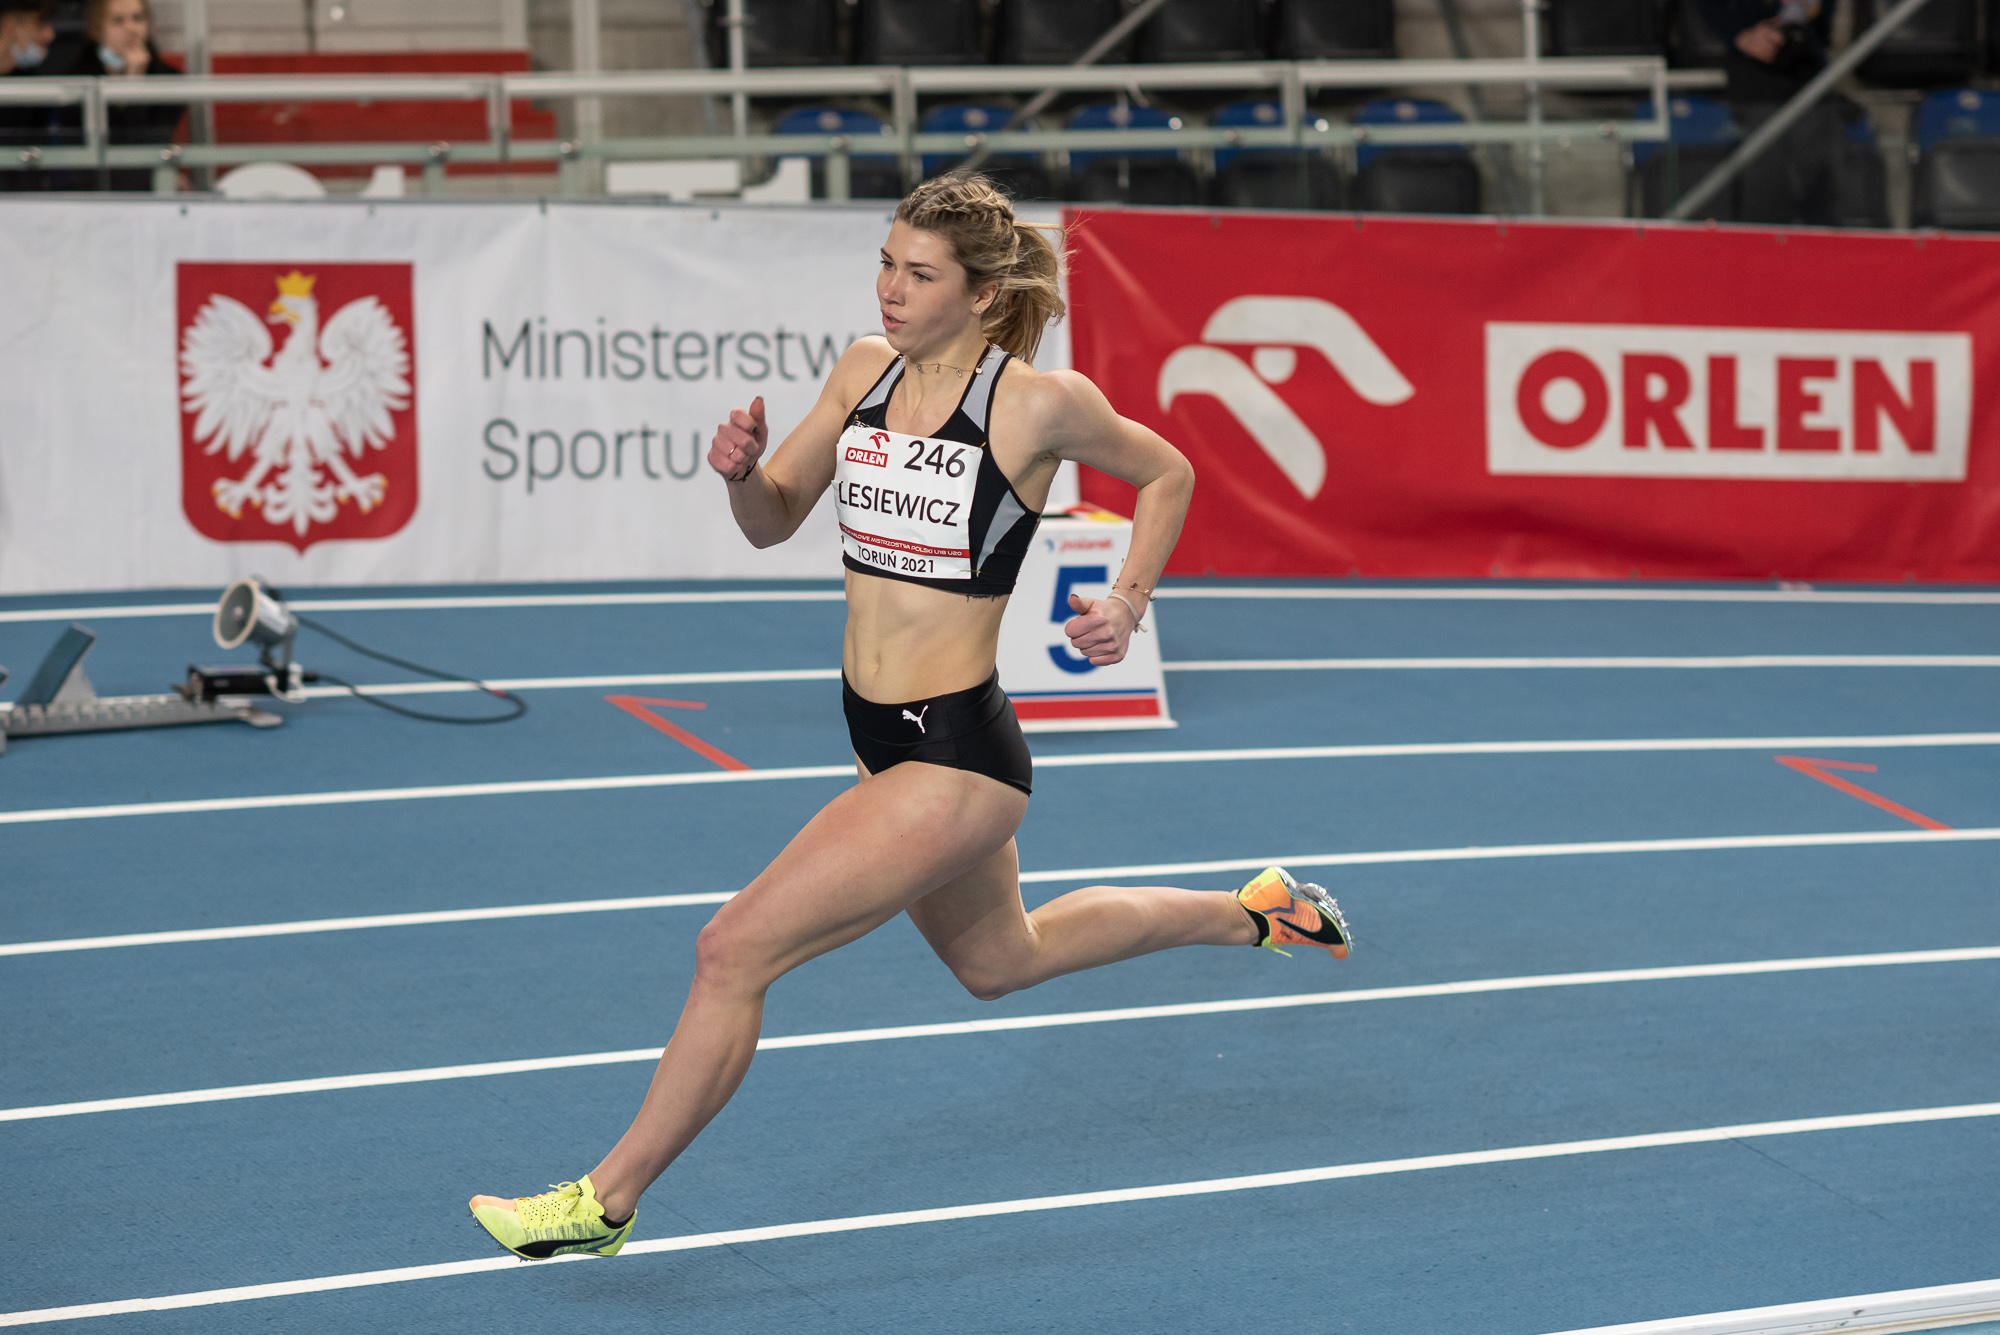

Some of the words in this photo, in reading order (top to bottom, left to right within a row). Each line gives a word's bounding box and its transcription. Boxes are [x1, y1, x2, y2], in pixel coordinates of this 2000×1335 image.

[483, 318, 886, 380] Ministerstw
[1516, 347, 1936, 453] ORLEN
[483, 418, 700, 494] Sportu
[847, 449, 886, 466] ORLEN
[903, 440, 966, 478] 246
[838, 480, 961, 528] LESIEWICZ
[857, 544, 897, 568] TORUŃ
[900, 556, 934, 573] 2021
[871, 536, 911, 550] MISTRZOSTWA
[911, 545, 933, 555] POLSKI
[1048, 564, 1108, 675] 5
